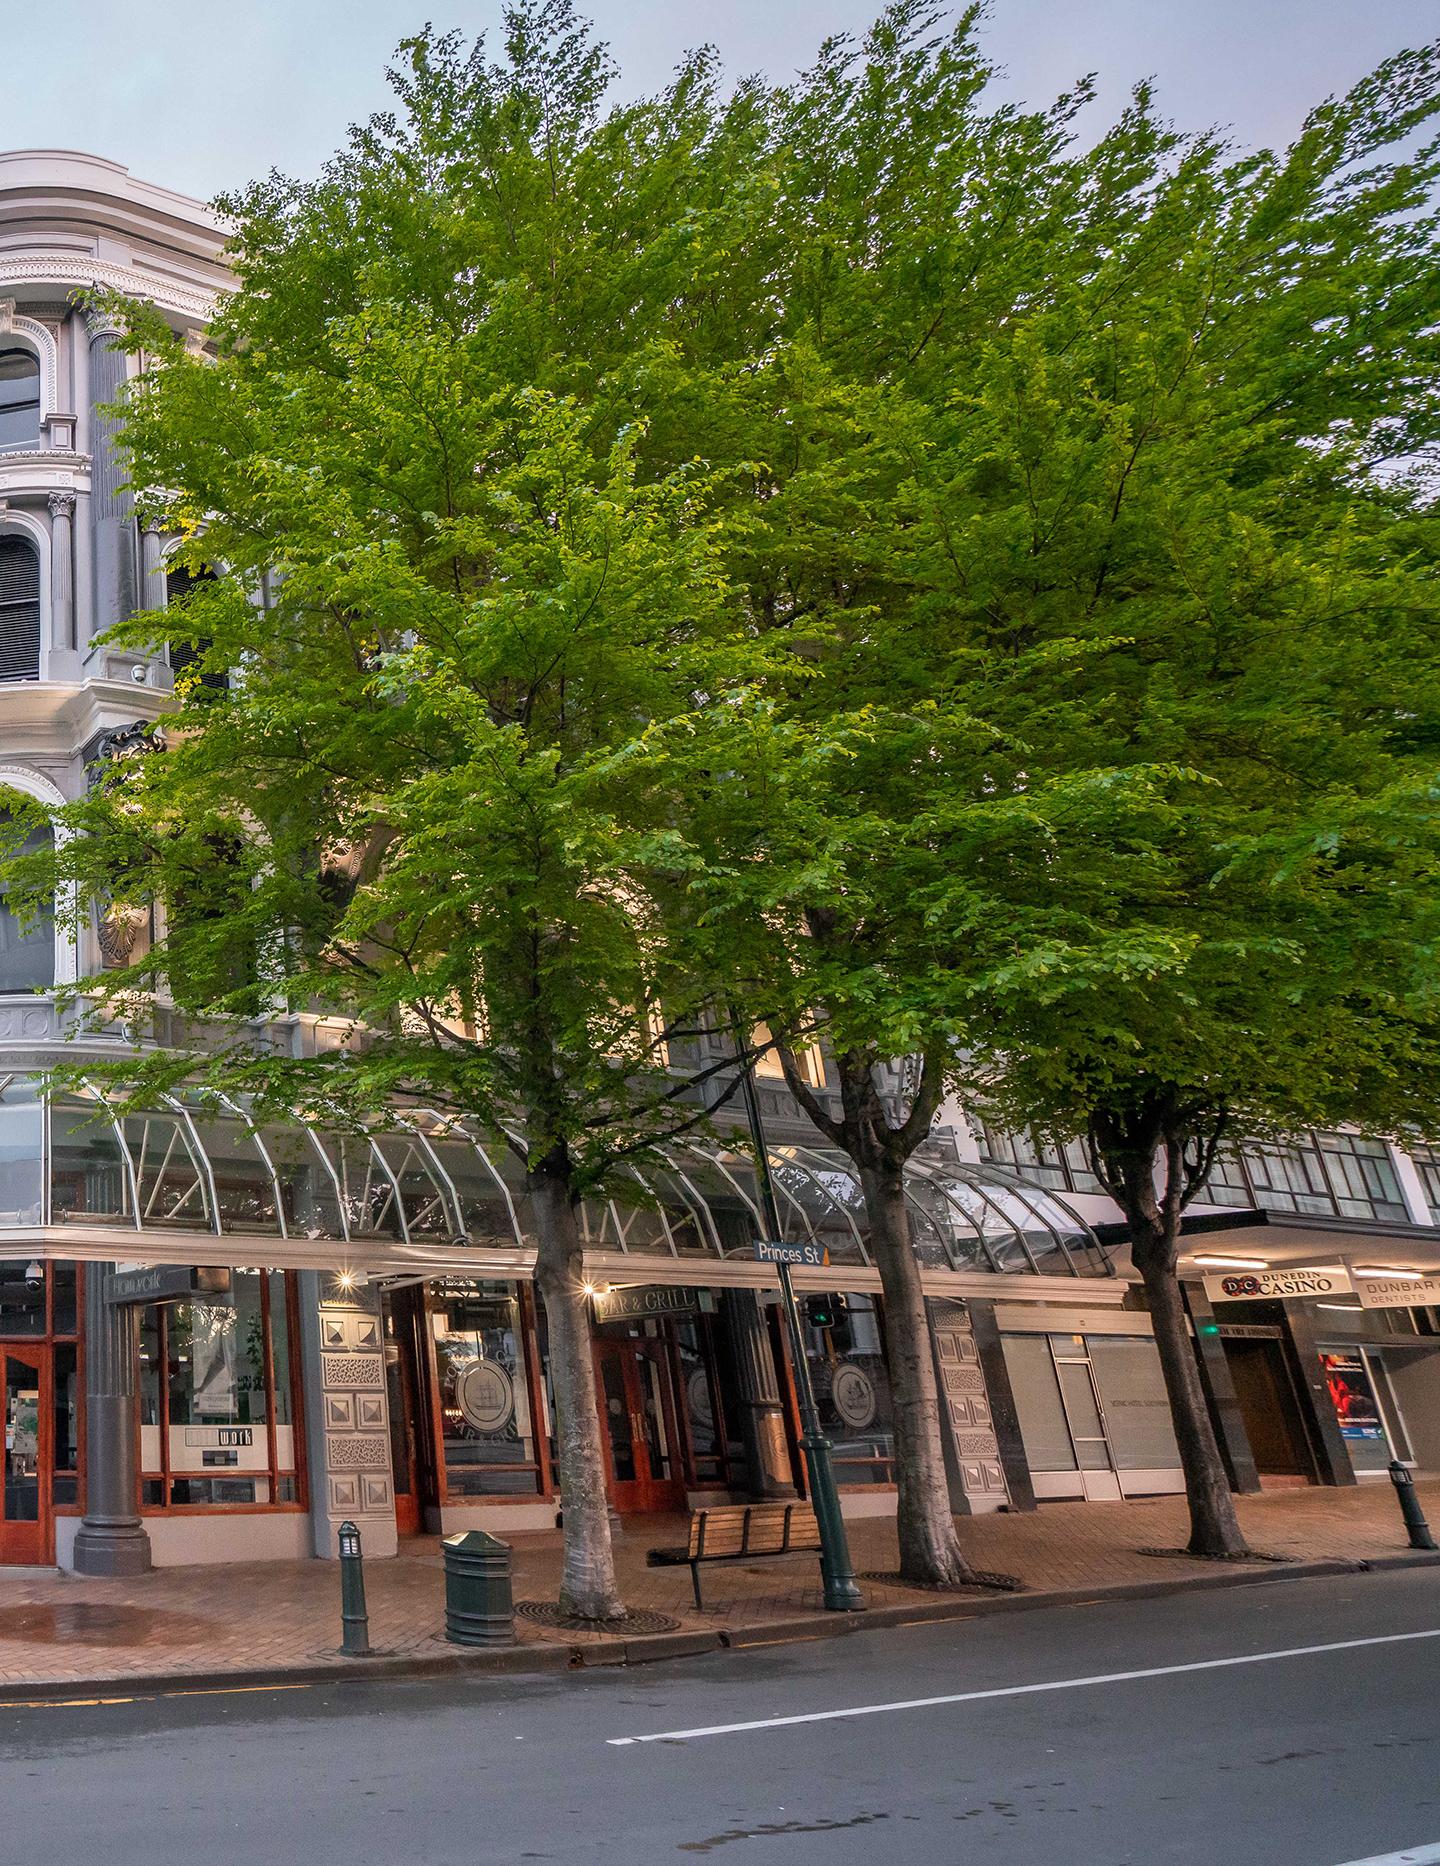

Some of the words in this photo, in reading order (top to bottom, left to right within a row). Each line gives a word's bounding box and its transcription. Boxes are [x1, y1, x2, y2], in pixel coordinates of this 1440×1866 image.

[759, 1243, 802, 1262] Princes
[804, 1246, 820, 1264] St
[1262, 1271, 1321, 1282] DUNEDIN
[1259, 1279, 1332, 1295] CASINO
[1366, 1281, 1435, 1294] DUNBAR
[599, 1296, 629, 1315] BAR
[632, 1296, 640, 1311] &
[645, 1288, 696, 1310] GRILL
[1371, 1294, 1426, 1303] DENTISTS
